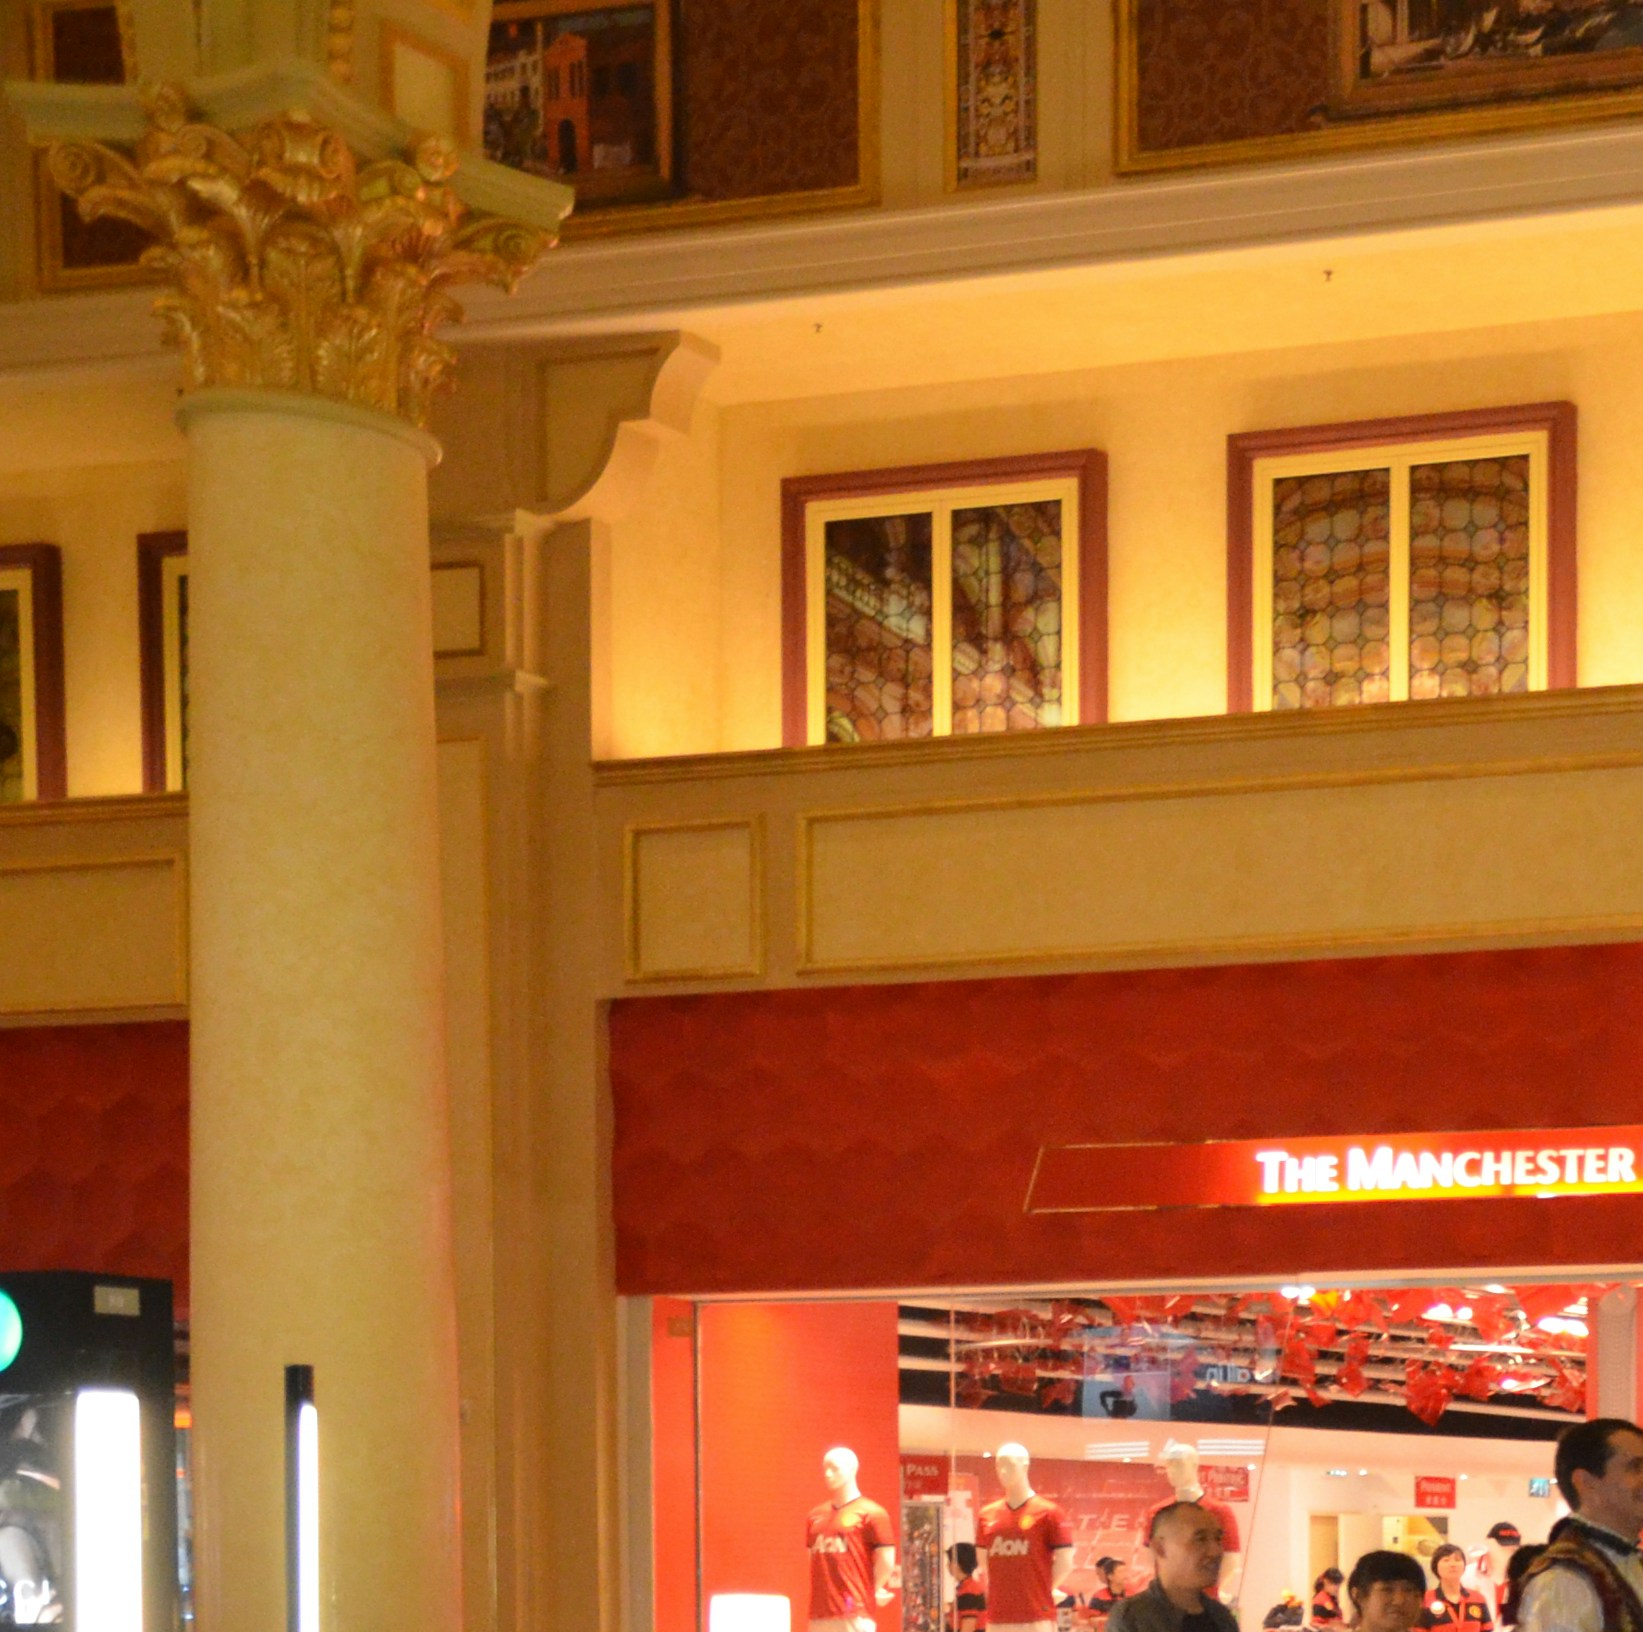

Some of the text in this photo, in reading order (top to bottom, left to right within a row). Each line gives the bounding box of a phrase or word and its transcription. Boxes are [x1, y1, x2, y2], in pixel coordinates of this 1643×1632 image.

[1256, 1150, 1339, 1194] THE
[1347, 1145, 1636, 1192] MANCHESTER
[989, 1535, 1030, 1556] AON
